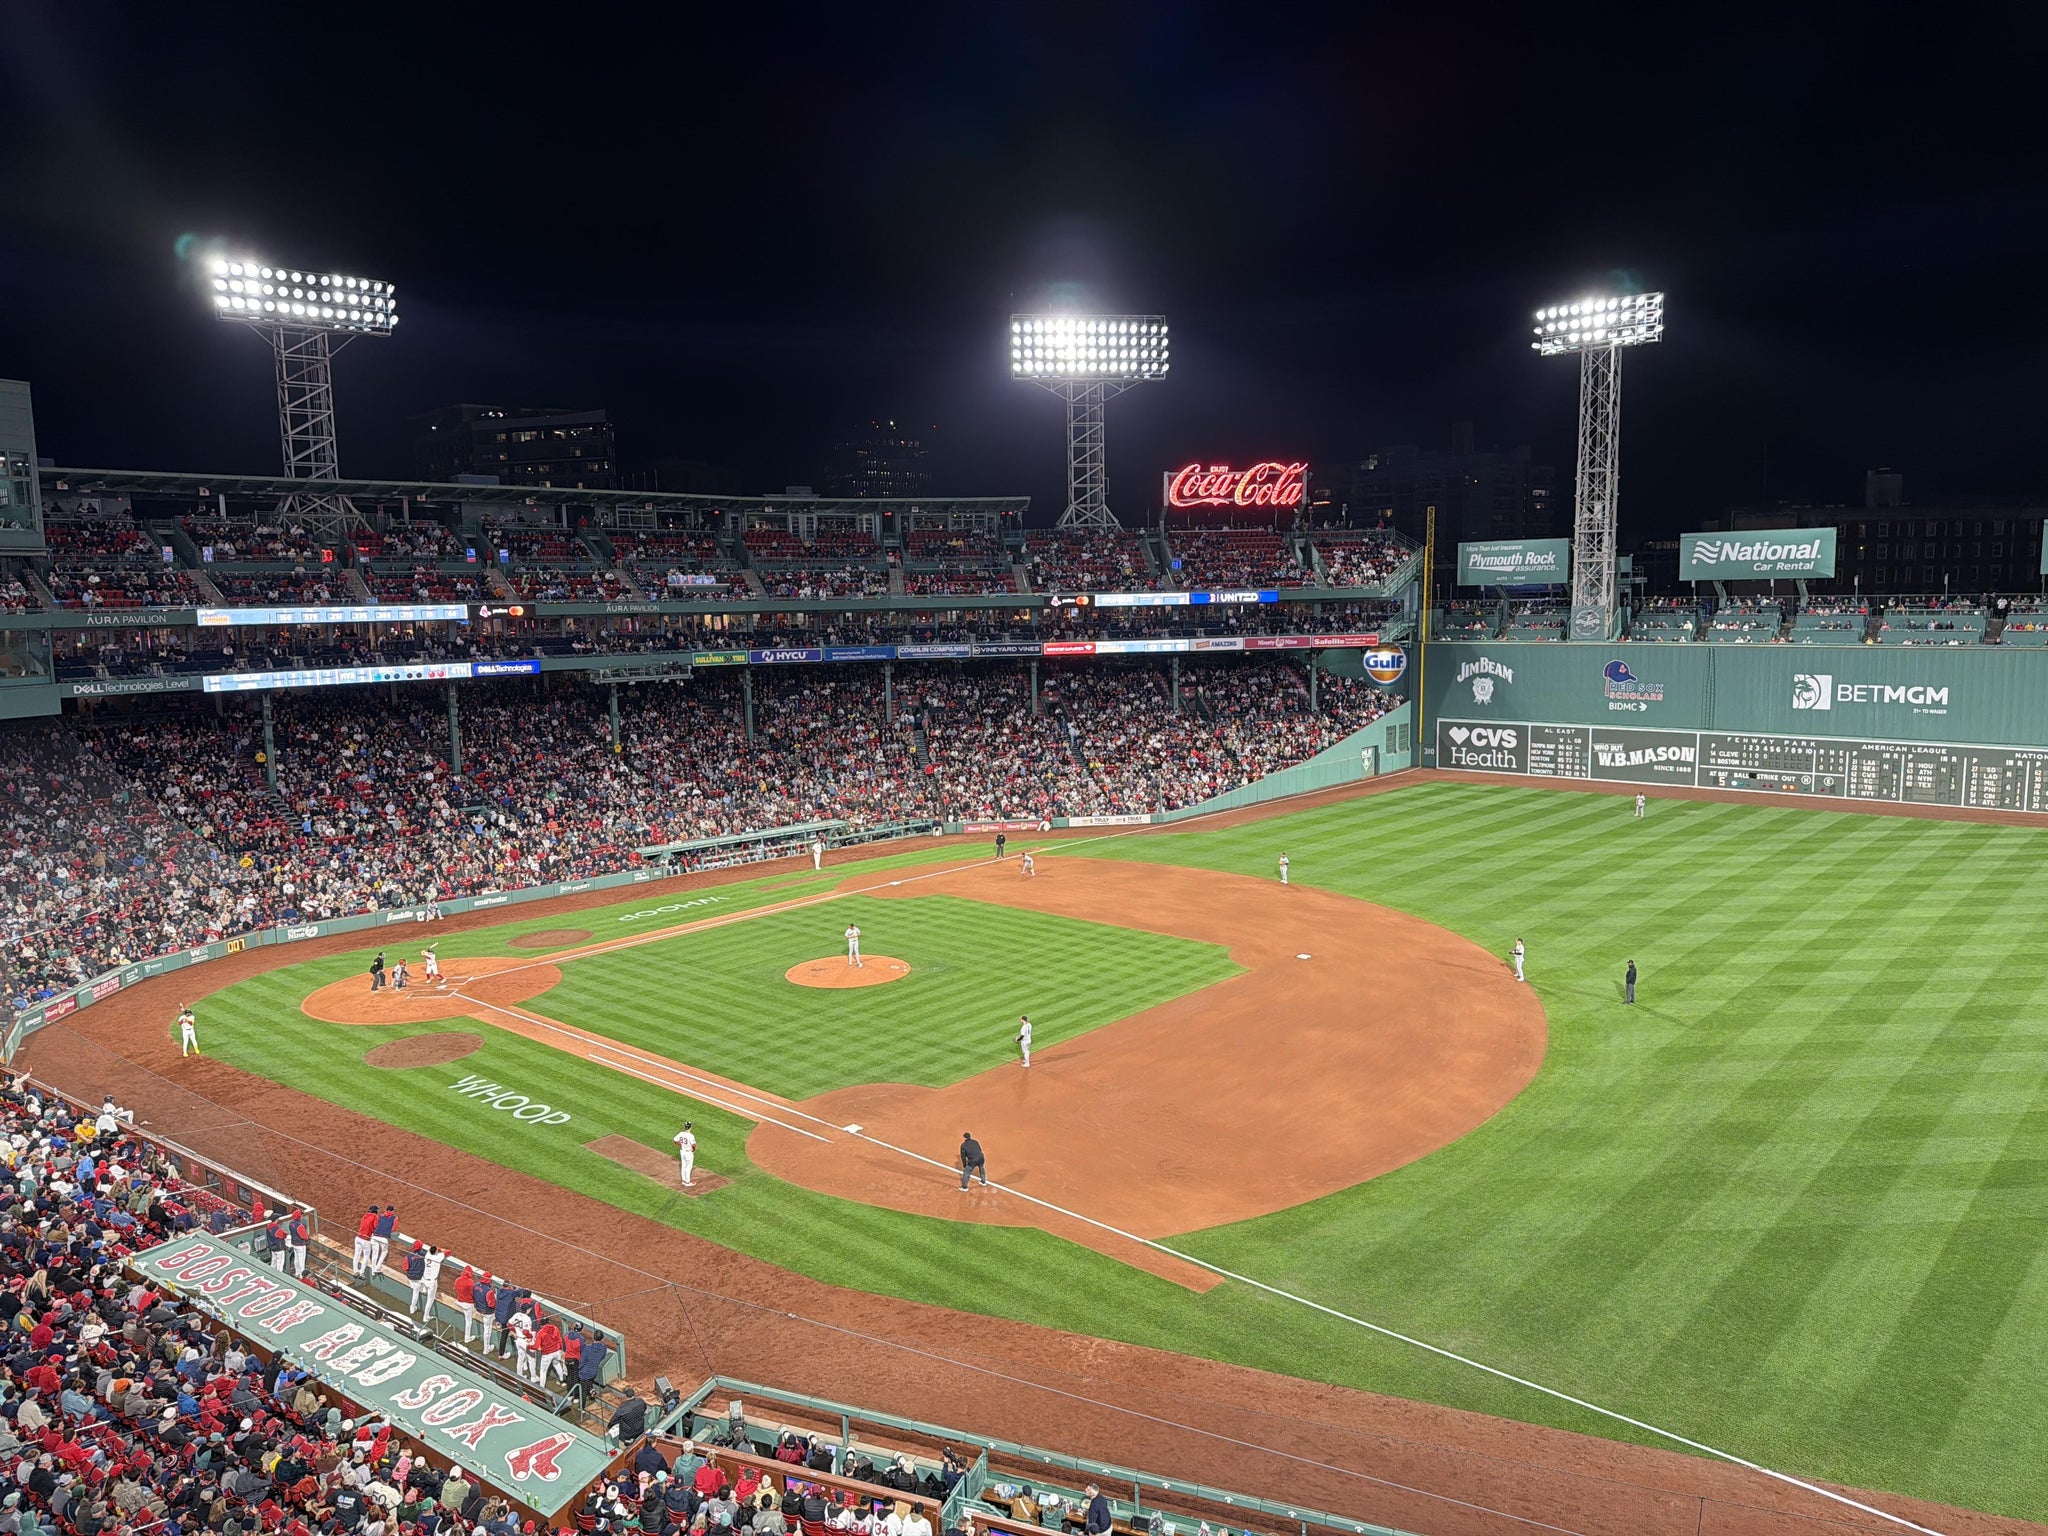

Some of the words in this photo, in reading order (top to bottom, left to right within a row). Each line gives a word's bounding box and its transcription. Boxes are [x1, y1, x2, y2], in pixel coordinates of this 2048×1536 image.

[1169, 462, 1308, 506] Coca-Cola
[1469, 552, 1523, 568] Plymouth
[1525, 551, 1556, 565] Rock
[1753, 562, 1772, 571] Car
[1776, 561, 1814, 570] Rental
[1220, 593, 1258, 602] UNITED
[123, 615, 166, 624] PAVILION
[695, 653, 724, 663] SULLIVAN
[733, 654, 745, 662] TIRE
[1365, 654, 1404, 669] Gulf
[1457, 661, 1480, 683] JIM
[1479, 657, 1514, 684] BEAM
[104, 681, 163, 692] Technologies
[166, 679, 189, 689] Level
[1610, 682, 1635, 692] RED
[1639, 683, 1664, 693] SOX
[1609, 692, 1663, 701] SCHOLARS
[1837, 684, 1949, 705] BETMGM
[1608, 702, 1637, 711] BIDMC
[1471, 728, 1517, 748] CVS
[1727, 737, 1775, 745] FENWAY
[1451, 747, 1517, 768] Health
[619, 896, 730, 922] WHOOP
[448, 1074, 571, 1124] WHOOP
[154, 1243, 325, 1335] BOSTON
[300, 1322, 417, 1386] RED
[390, 1374, 526, 1451] SOX
[371, 1492, 387, 1505] 50
[851, 1522, 866, 1534] 34
[874, 1523, 888, 1535] 34
